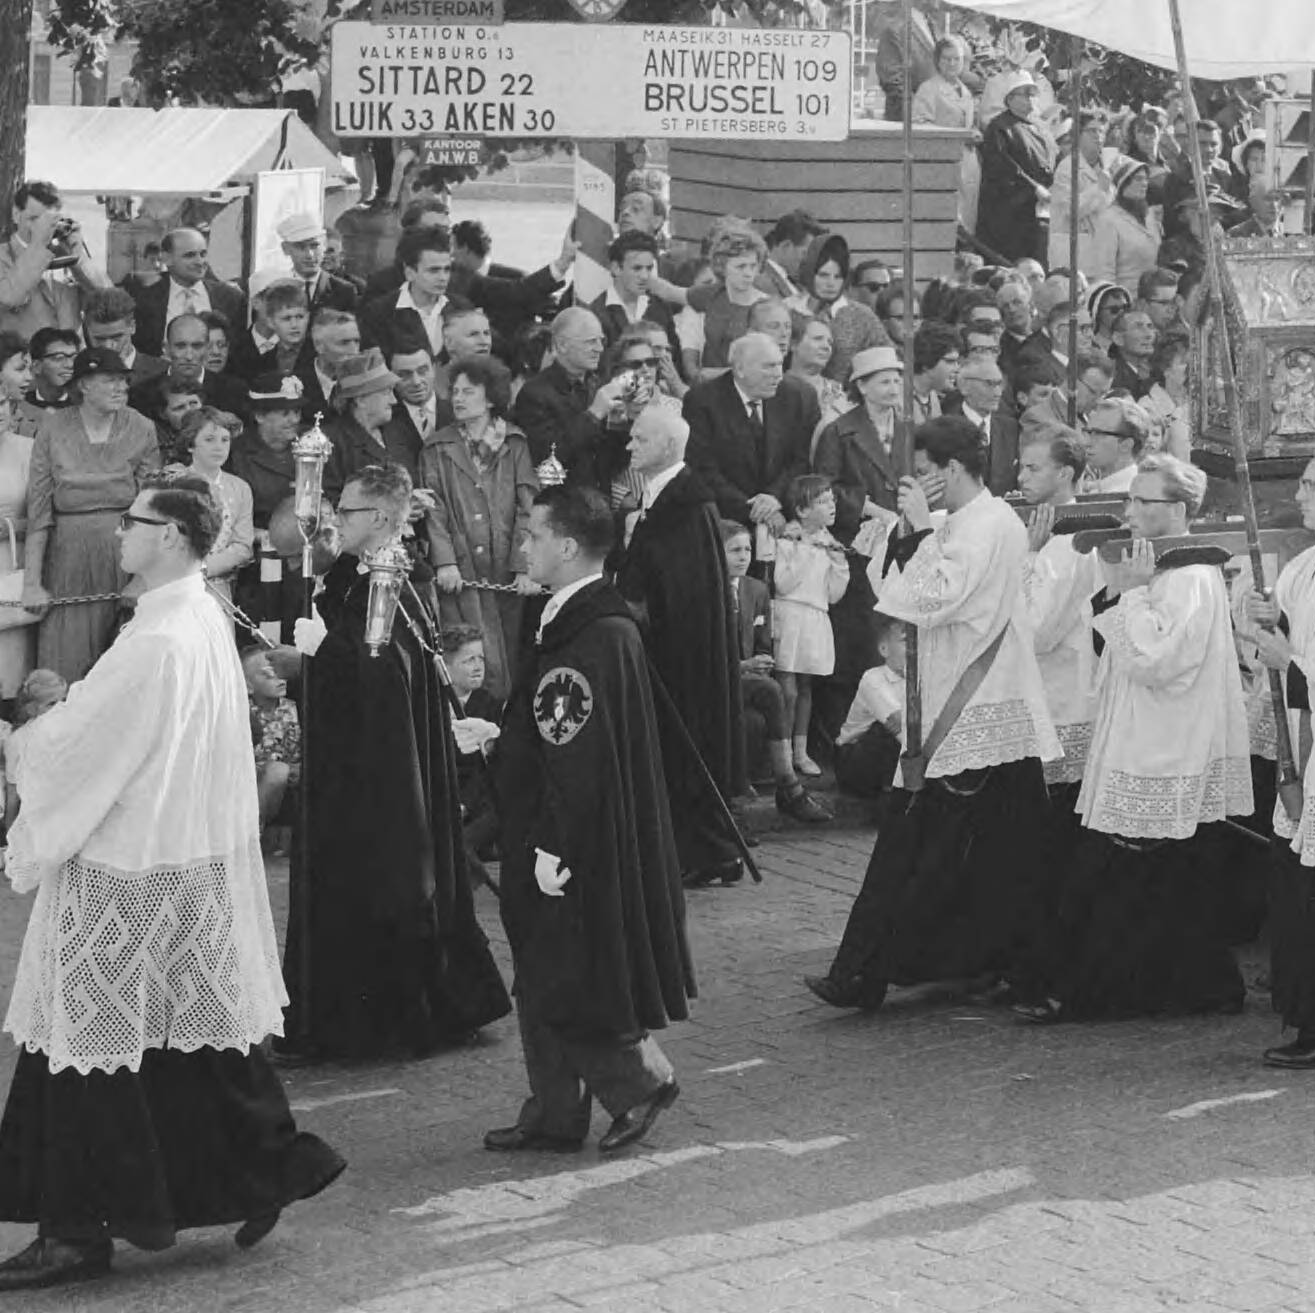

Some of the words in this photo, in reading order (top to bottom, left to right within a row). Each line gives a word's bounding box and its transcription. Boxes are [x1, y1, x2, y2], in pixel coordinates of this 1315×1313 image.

[381, 0, 494, 17] AMSTERDAM
[386, 27, 465, 40] STATION
[643, 30, 713, 43] MAASEIK
[718, 31, 732, 44] 31
[741, 31, 804, 46] HASSELT
[811, 35, 830, 48] 27
[360, 46, 487, 59] VALKENBURG
[499, 47, 513, 60] 13
[644, 49, 784, 80] ANTWERPEN
[795, 60, 837, 82] 109
[358, 66, 486, 95] SITTARD
[501, 73, 533, 95] 22
[645, 83, 784, 114] BRUSSEL
[797, 94, 829, 116] 101
[335, 101, 393, 131] LUIK
[401, 109, 434, 131] 33
[445, 102, 514, 131] AKEN
[523, 109, 555, 131] 30
[686, 119, 786, 133] PIETERSBERG
[425, 140, 481, 150] KANTOOR
